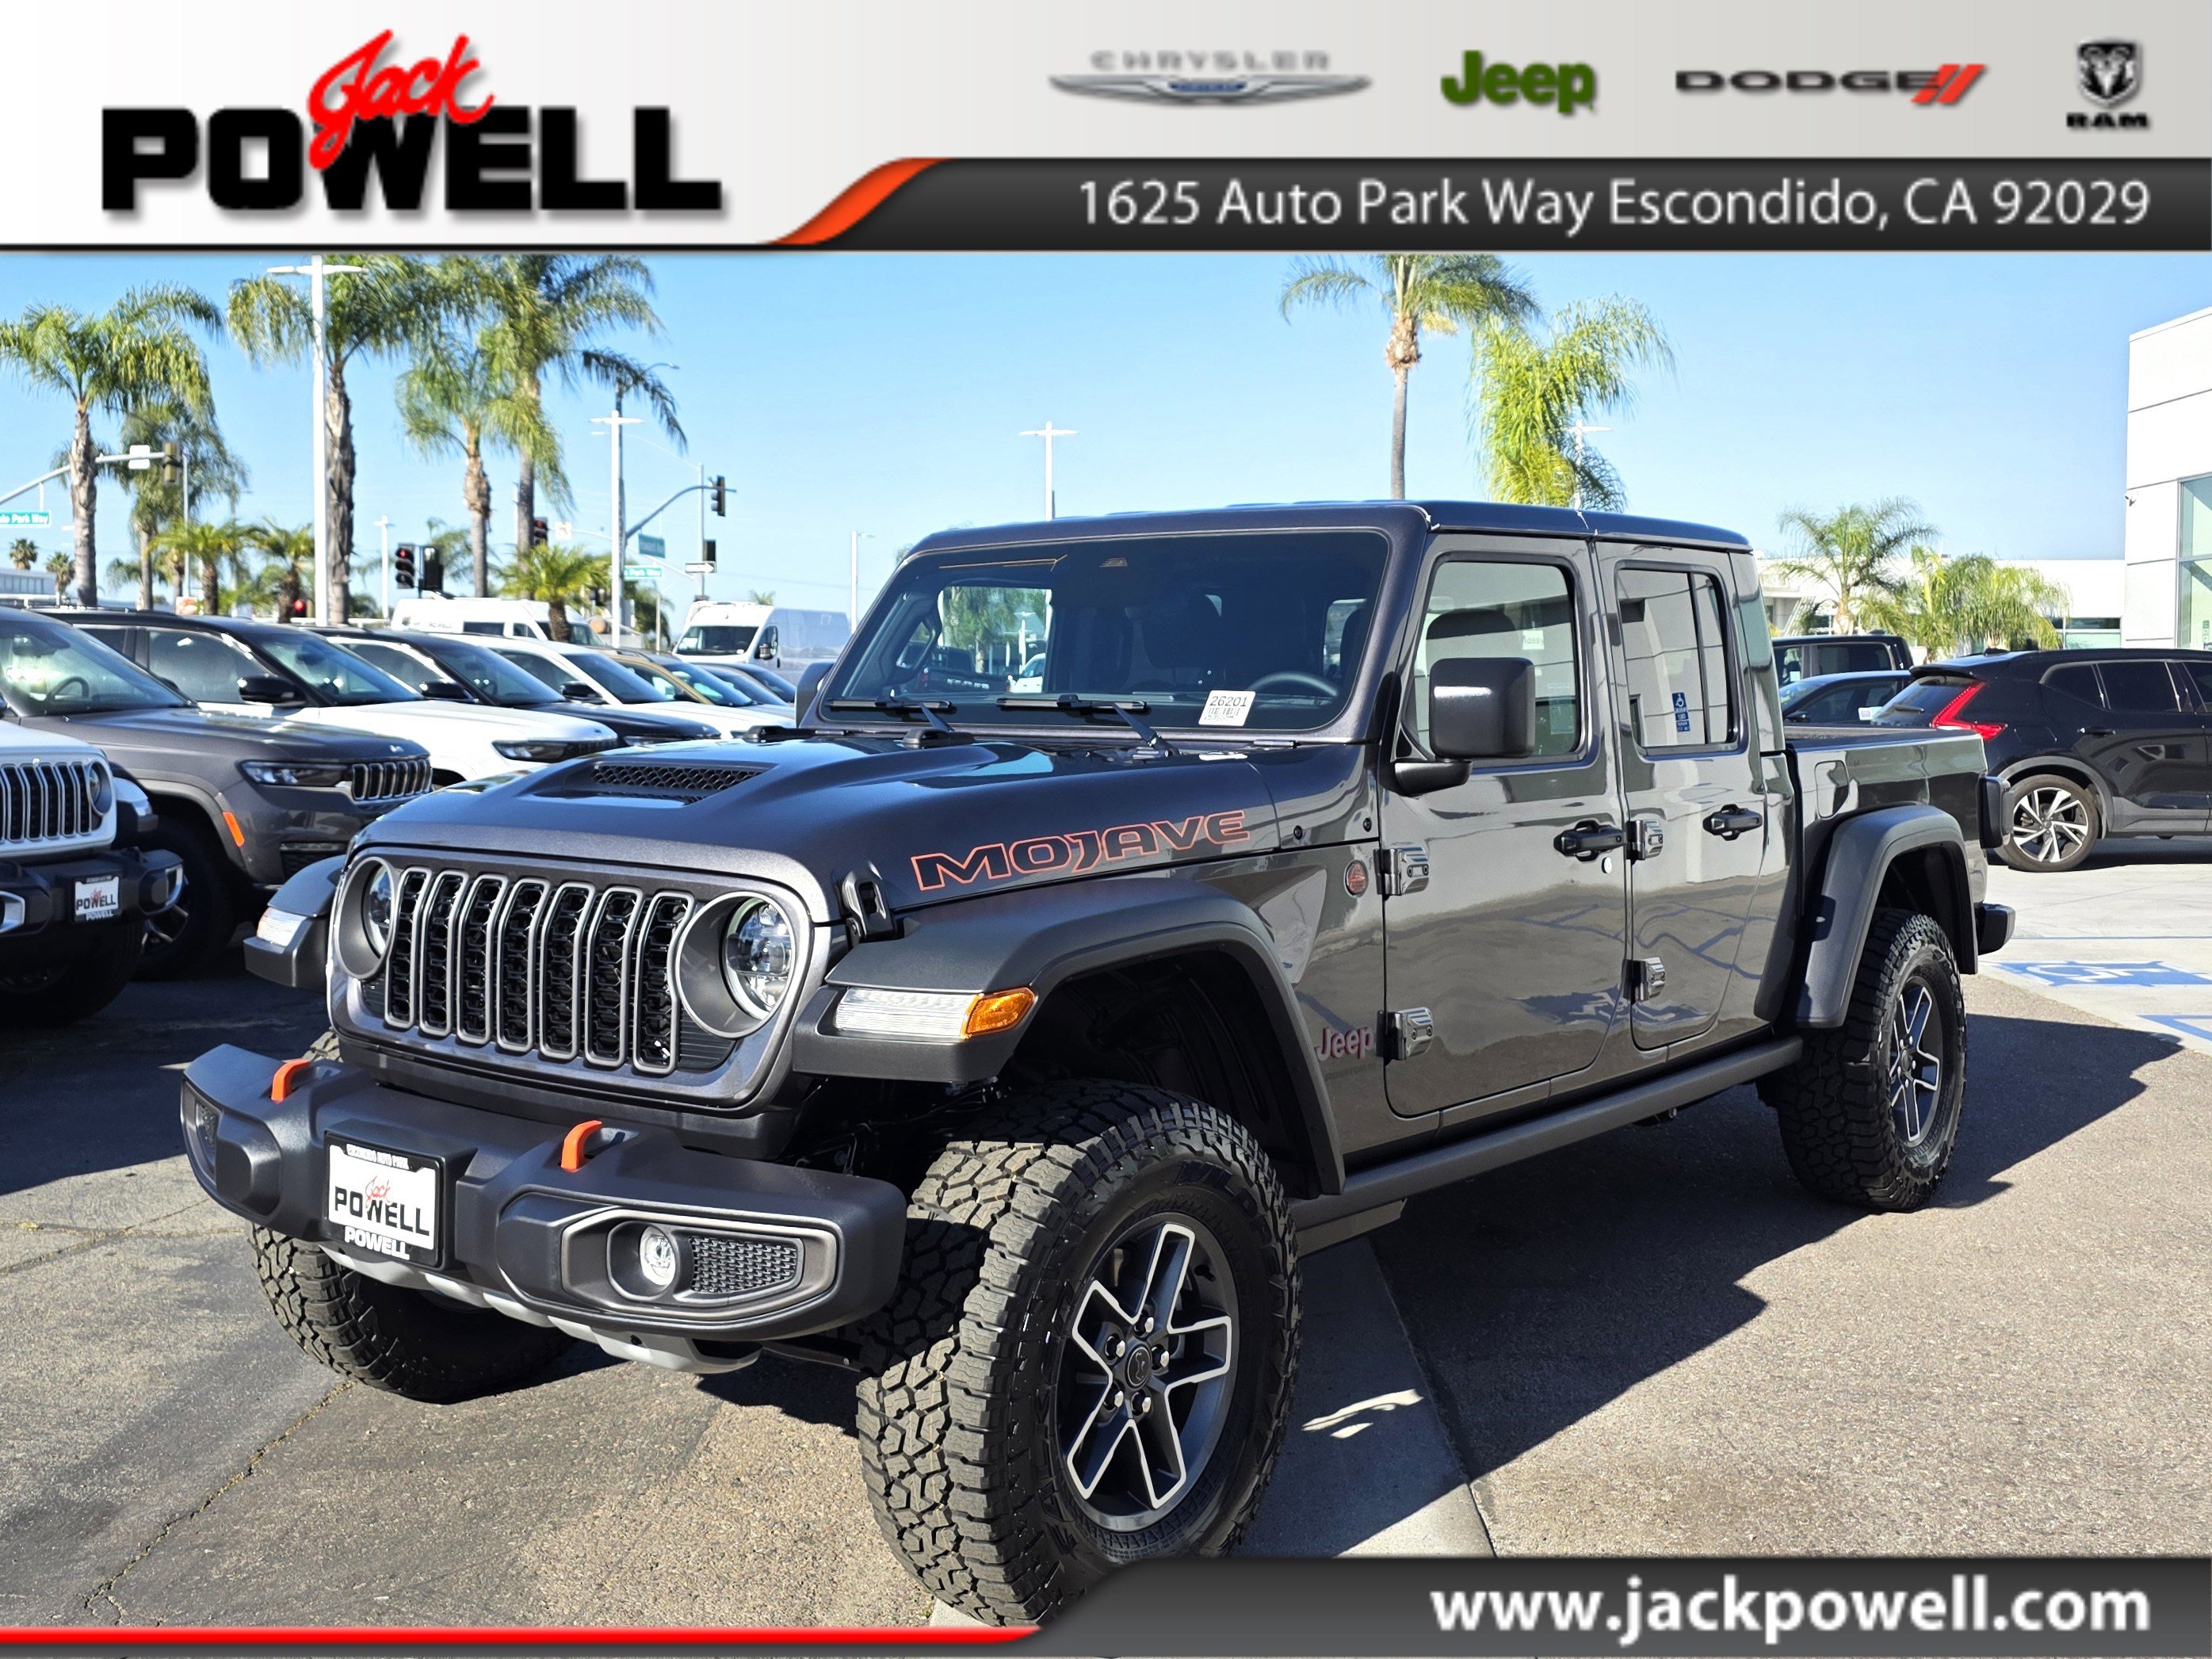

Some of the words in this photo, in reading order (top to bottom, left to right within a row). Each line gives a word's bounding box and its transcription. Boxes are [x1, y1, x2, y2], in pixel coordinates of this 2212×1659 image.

[1209, 695, 1247, 707] 26201
[911, 810, 1250, 891] MOJAVE
[76, 894, 117, 911] POWELL
[1313, 1026, 1374, 1062] Jeep
[365, 1175, 394, 1210] Jack
[334, 1186, 430, 1237] POWELL
[344, 1225, 411, 1261] POWELL
